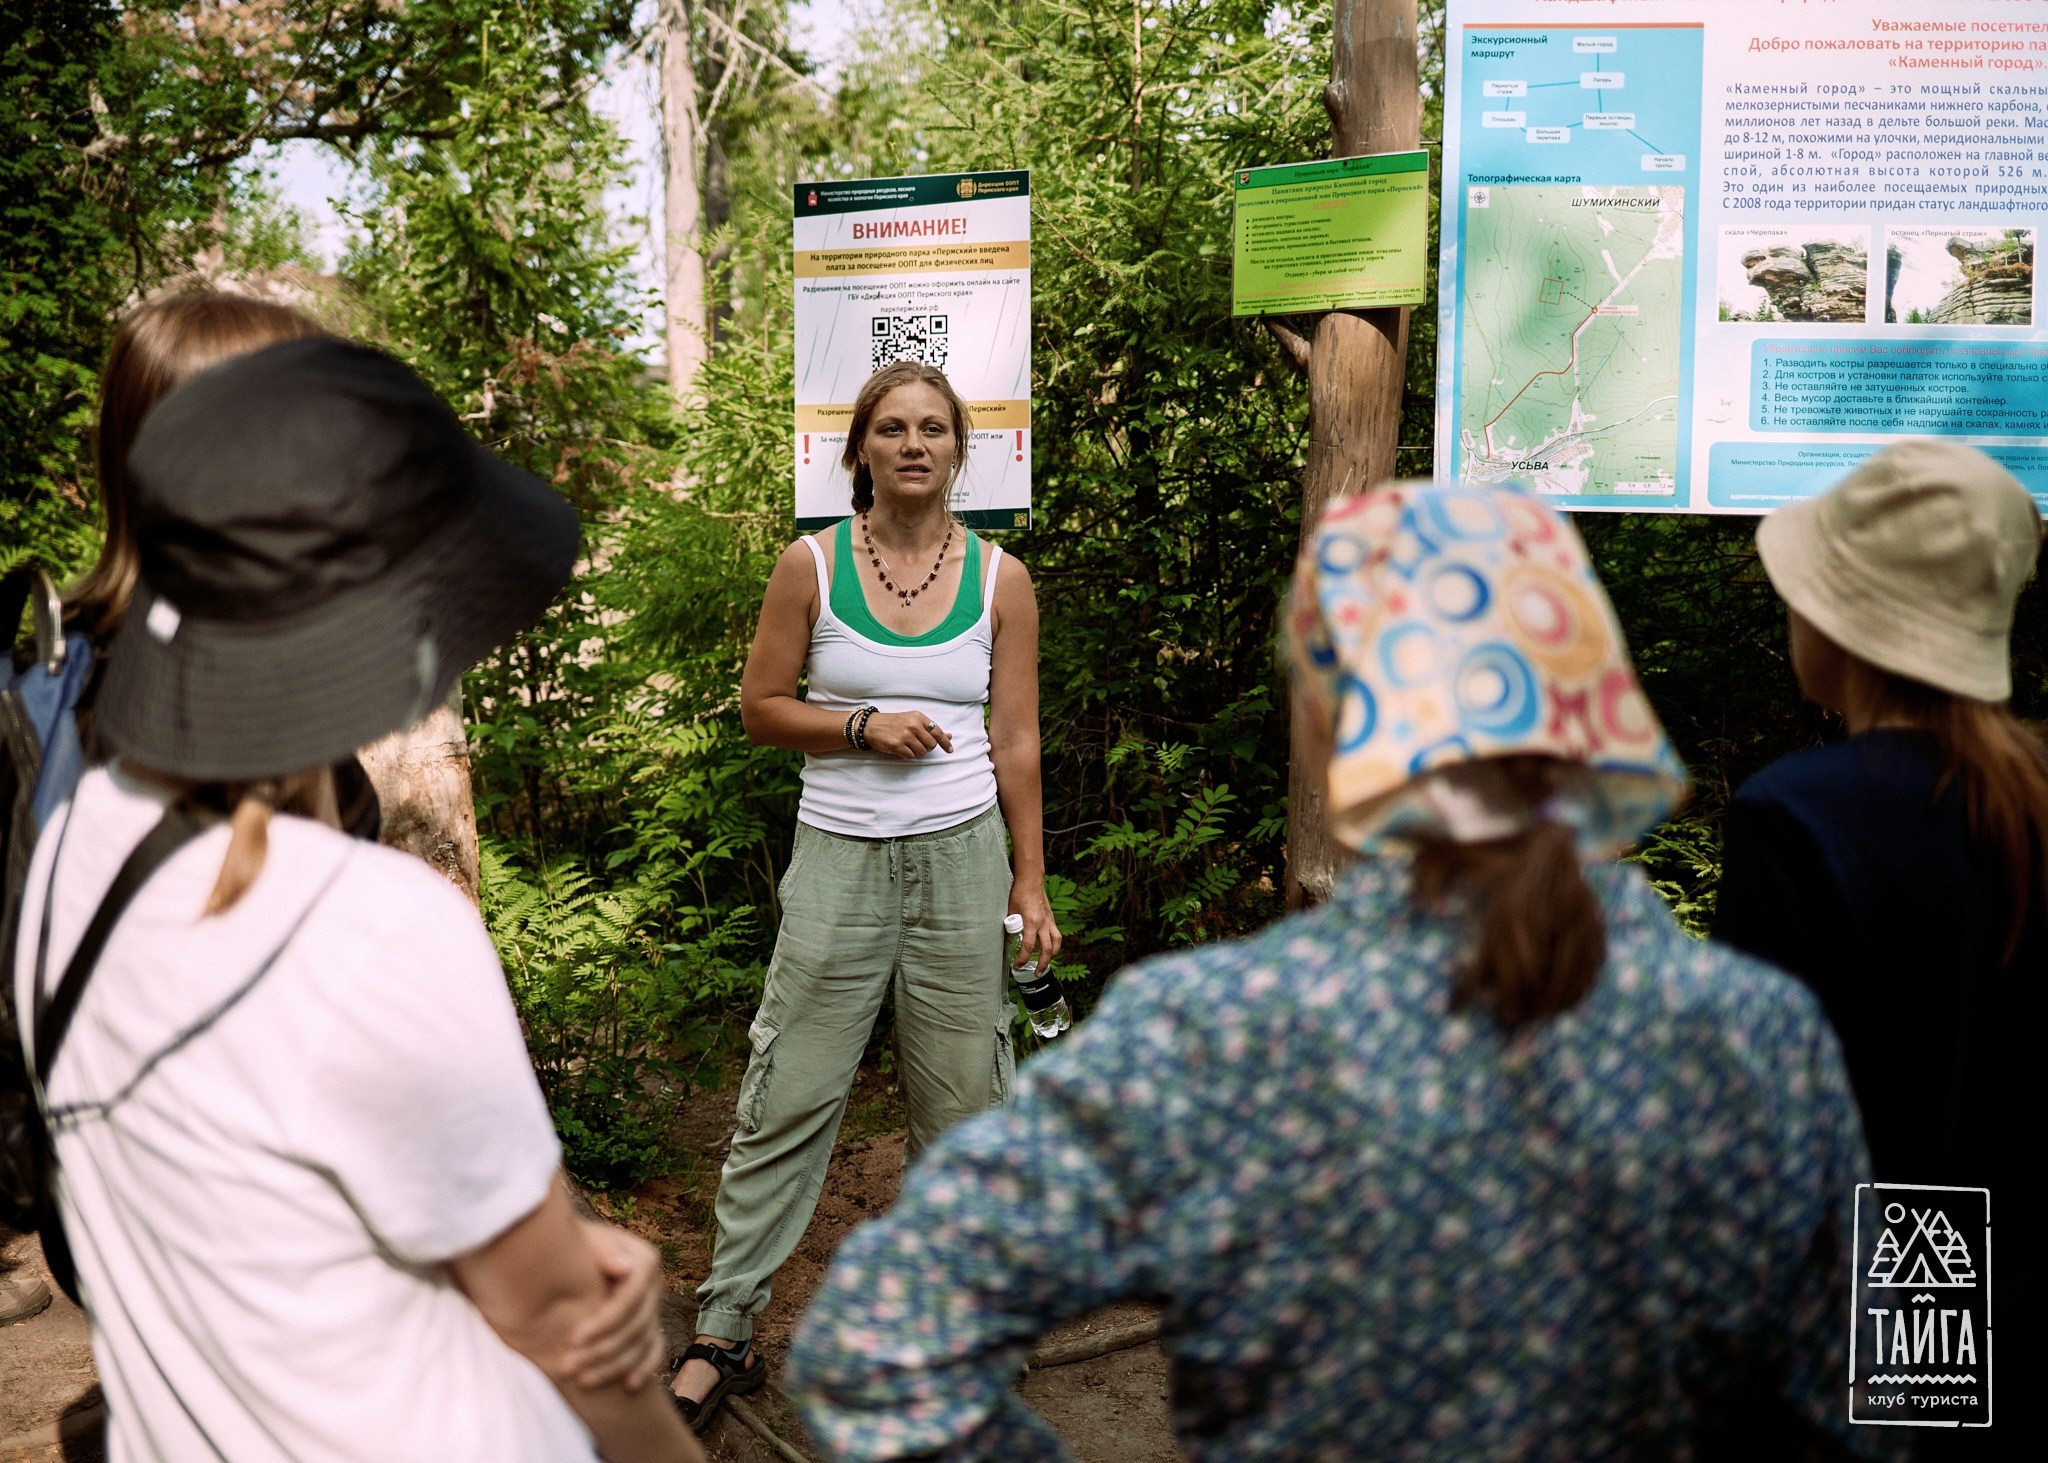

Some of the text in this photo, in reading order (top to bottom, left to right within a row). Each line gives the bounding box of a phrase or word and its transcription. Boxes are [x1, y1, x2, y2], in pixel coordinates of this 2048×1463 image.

[1872, 18, 1966, 31] Уважаемые
[1470, 35, 1548, 45] Экскурсионный
[1748, 36, 1800, 52] Добро
[1804, 39, 1900, 49] пожаловать
[1904, 39, 1923, 49] на
[1927, 40, 2024, 53] территорию
[1470, 51, 1514, 59] маршрут
[1888, 55, 2048, 72] «Каменный город».
[1726, 81, 2048, 97] «Каменный город» это мощный скальны
[1725, 101, 1840, 113] мелкозернистыми
[1844, 101, 1926, 110] песчаниками
[1930, 101, 1983, 110] нижнего
[1987, 99, 2041, 114] карбона,
[1724, 117, 1795, 126] миллионов
[1800, 118, 1820, 126] лет
[1825, 117, 1861, 129] назад
[1866, 117, 1873, 126] в
[1878, 118, 1920, 129] дельте
[1925, 115, 1980, 127] большой
[1985, 118, 2018, 130] реки.
[1724, 131, 2044, 146] до 8-12 м, похожими на улочки, меридиональными
[1724, 147, 1781, 162] шириной
[1785, 148, 1804, 159] 1-8
[1808, 150, 1821, 159] м.
[1831, 148, 1881, 162] «Город»
[1885, 150, 1961, 162] расположен
[1965, 151, 1980, 160] на
[1984, 148, 2033, 161] главной
[1723, 164, 2048, 179] спой, абсолютная высота которой 526 м.
[1468, 174, 1581, 184] Топографическая карта
[1271, 178, 1387, 195] Памятник природы Каменный город
[1723, 180, 2048, 196] Это один из наиболее посещаемых природных
[1571, 197, 1660, 207] ШУМИХИНСКИЙ
[1722, 197, 1730, 208] С
[1733, 197, 1761, 208] 2008
[1764, 199, 1791, 210] года
[1794, 199, 1866, 211] территории
[1869, 200, 1915, 211] придан
[1918, 200, 1955, 211] статус
[852, 218, 966, 239] ВНИМАНИЕ!
[1890, 230, 1919, 238] останец
[1920, 229, 1961, 238] «Пернатый
[821, 253, 863, 262] территории
[863, 251, 907, 260] природного
[931, 246, 977, 256] «Пермский»
[978, 246, 1010, 254] введена
[856, 262, 896, 270] посещение
[897, 259, 917, 267] ООПТ
[933, 259, 978, 267] физических
[802, 285, 842, 293] Разрешение
[851, 284, 887, 292] посещение
[931, 280, 965, 288] оформить
[860, 291, 896, 300] «Дирекция
[880, 304, 938, 314] паркпермский.рф
[1775, 359, 1827, 369] Разводить
[1829, 361, 1866, 370] костры
[1865, 362, 1932, 371] разрешается
[1978, 363, 2038, 372] специально
[1774, 370, 1794, 379] Для
[1796, 372, 1837, 381] костров
[1846, 373, 1899, 382] установки
[1941, 372, 2005, 384] используйте
[1774, 382, 1788, 390] Не
[1790, 382, 1849, 391] оставляйте
[1864, 385, 1925, 394] затушенных
[1927, 385, 1969, 395] костров.
[1774, 393, 1798, 402] Весь
[1800, 395, 1833, 404] мусор
[1832, 396, 1883, 404] доставьте
[1893, 395, 1952, 404] ближайший
[1954, 396, 2009, 407] контейнер.
[1773, 405, 1787, 413] Не
[1791, 407, 1843, 416] тревожьте
[1918, 407, 1975, 418] нарушайте
[1974, 409, 2037, 419] сохранность
[1773, 416, 1787, 425] Не
[1789, 417, 1846, 426] оставляйте
[1879, 418, 1904, 427] себя
[1906, 420, 1950, 429] надписи
[1964, 421, 2002, 429] скалах,
[1511, 461, 1549, 471] УСЬВА
